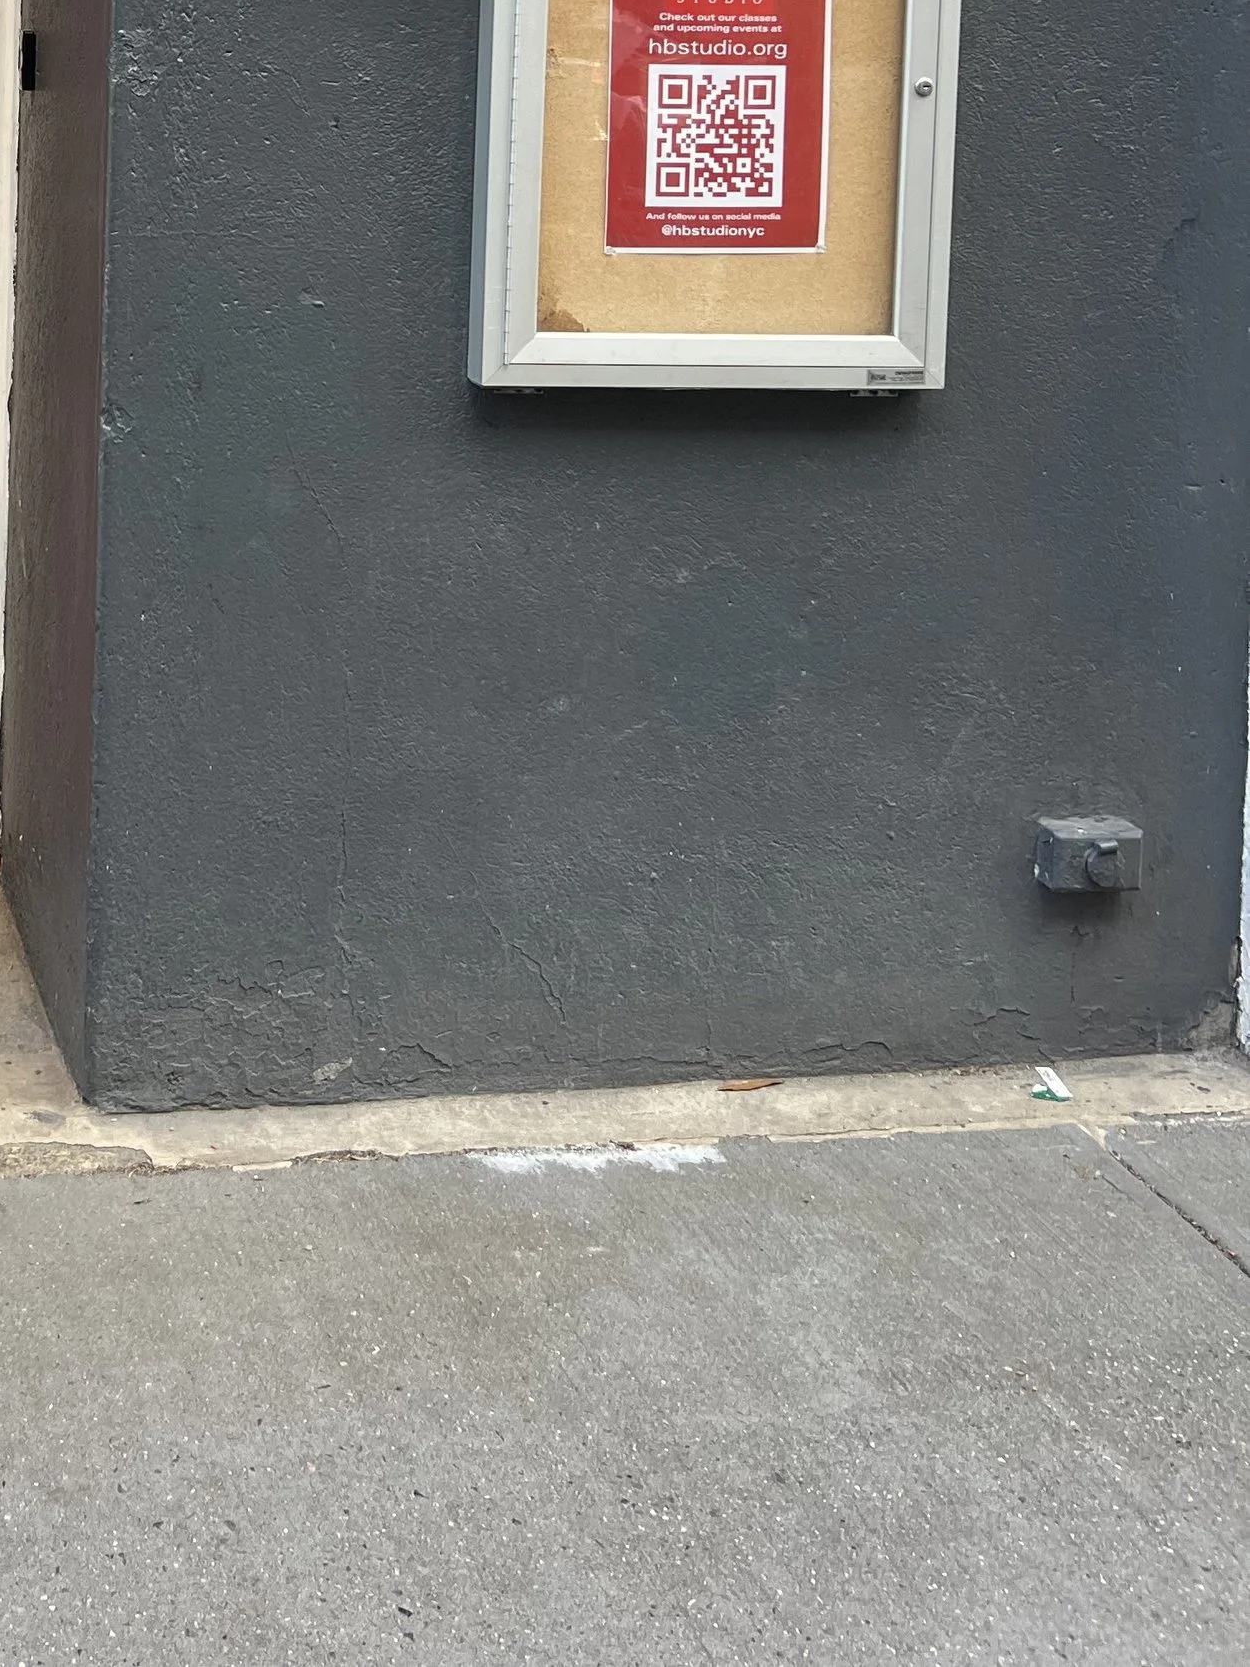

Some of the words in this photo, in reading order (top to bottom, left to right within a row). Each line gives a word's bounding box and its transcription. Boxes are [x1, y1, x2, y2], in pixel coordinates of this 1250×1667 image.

[659, 12, 694, 22] Check
[697, 14, 716, 22] out
[738, 14, 778, 22] classes
[653, 23, 674, 32] and
[677, 24, 730, 33] upcoming
[732, 25, 769, 33] events
[770, 25, 782, 33] at
[649, 38, 787, 59] hbstudio.org
[661, 224, 765, 238] @hbstudionyc
